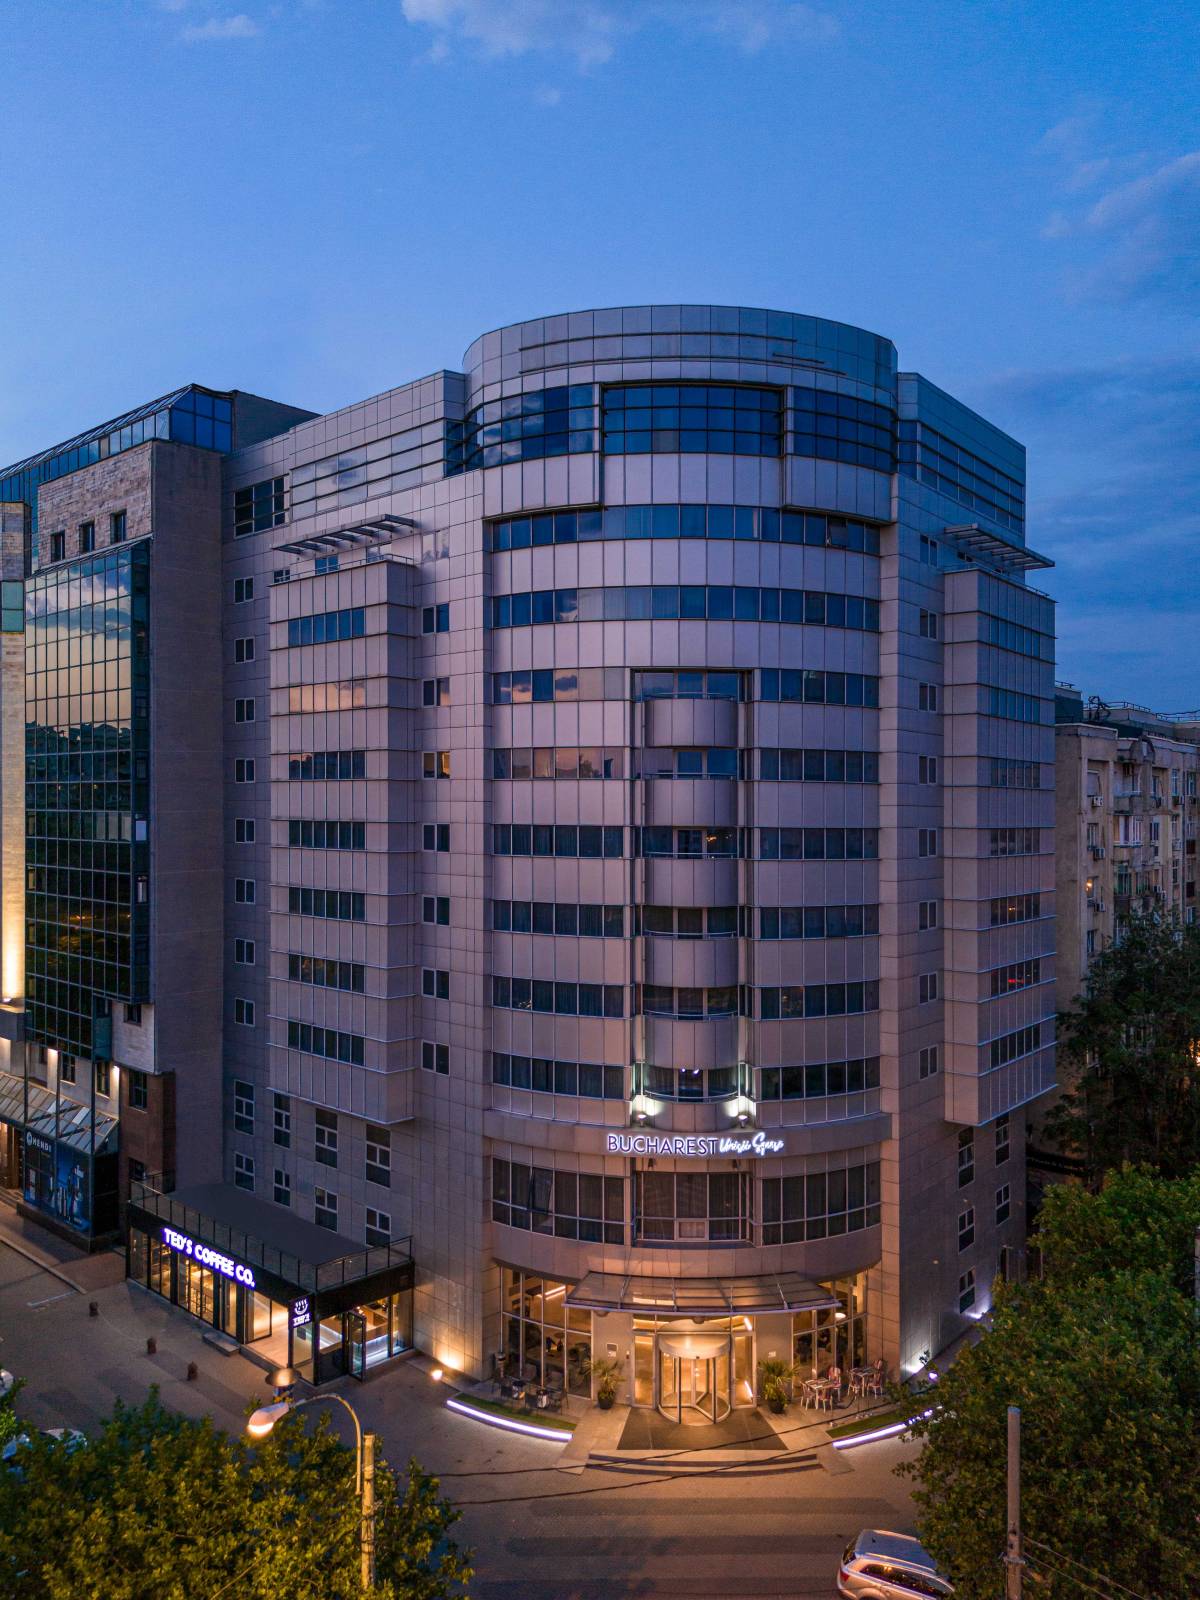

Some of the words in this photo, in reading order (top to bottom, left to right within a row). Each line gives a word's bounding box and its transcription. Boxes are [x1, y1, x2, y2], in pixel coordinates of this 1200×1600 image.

[608, 1133, 719, 1155] BUCHAREST
[163, 1227, 193, 1255] TED'S
[194, 1244, 235, 1277] COFFEE
[235, 1264, 256, 1288] CO.
